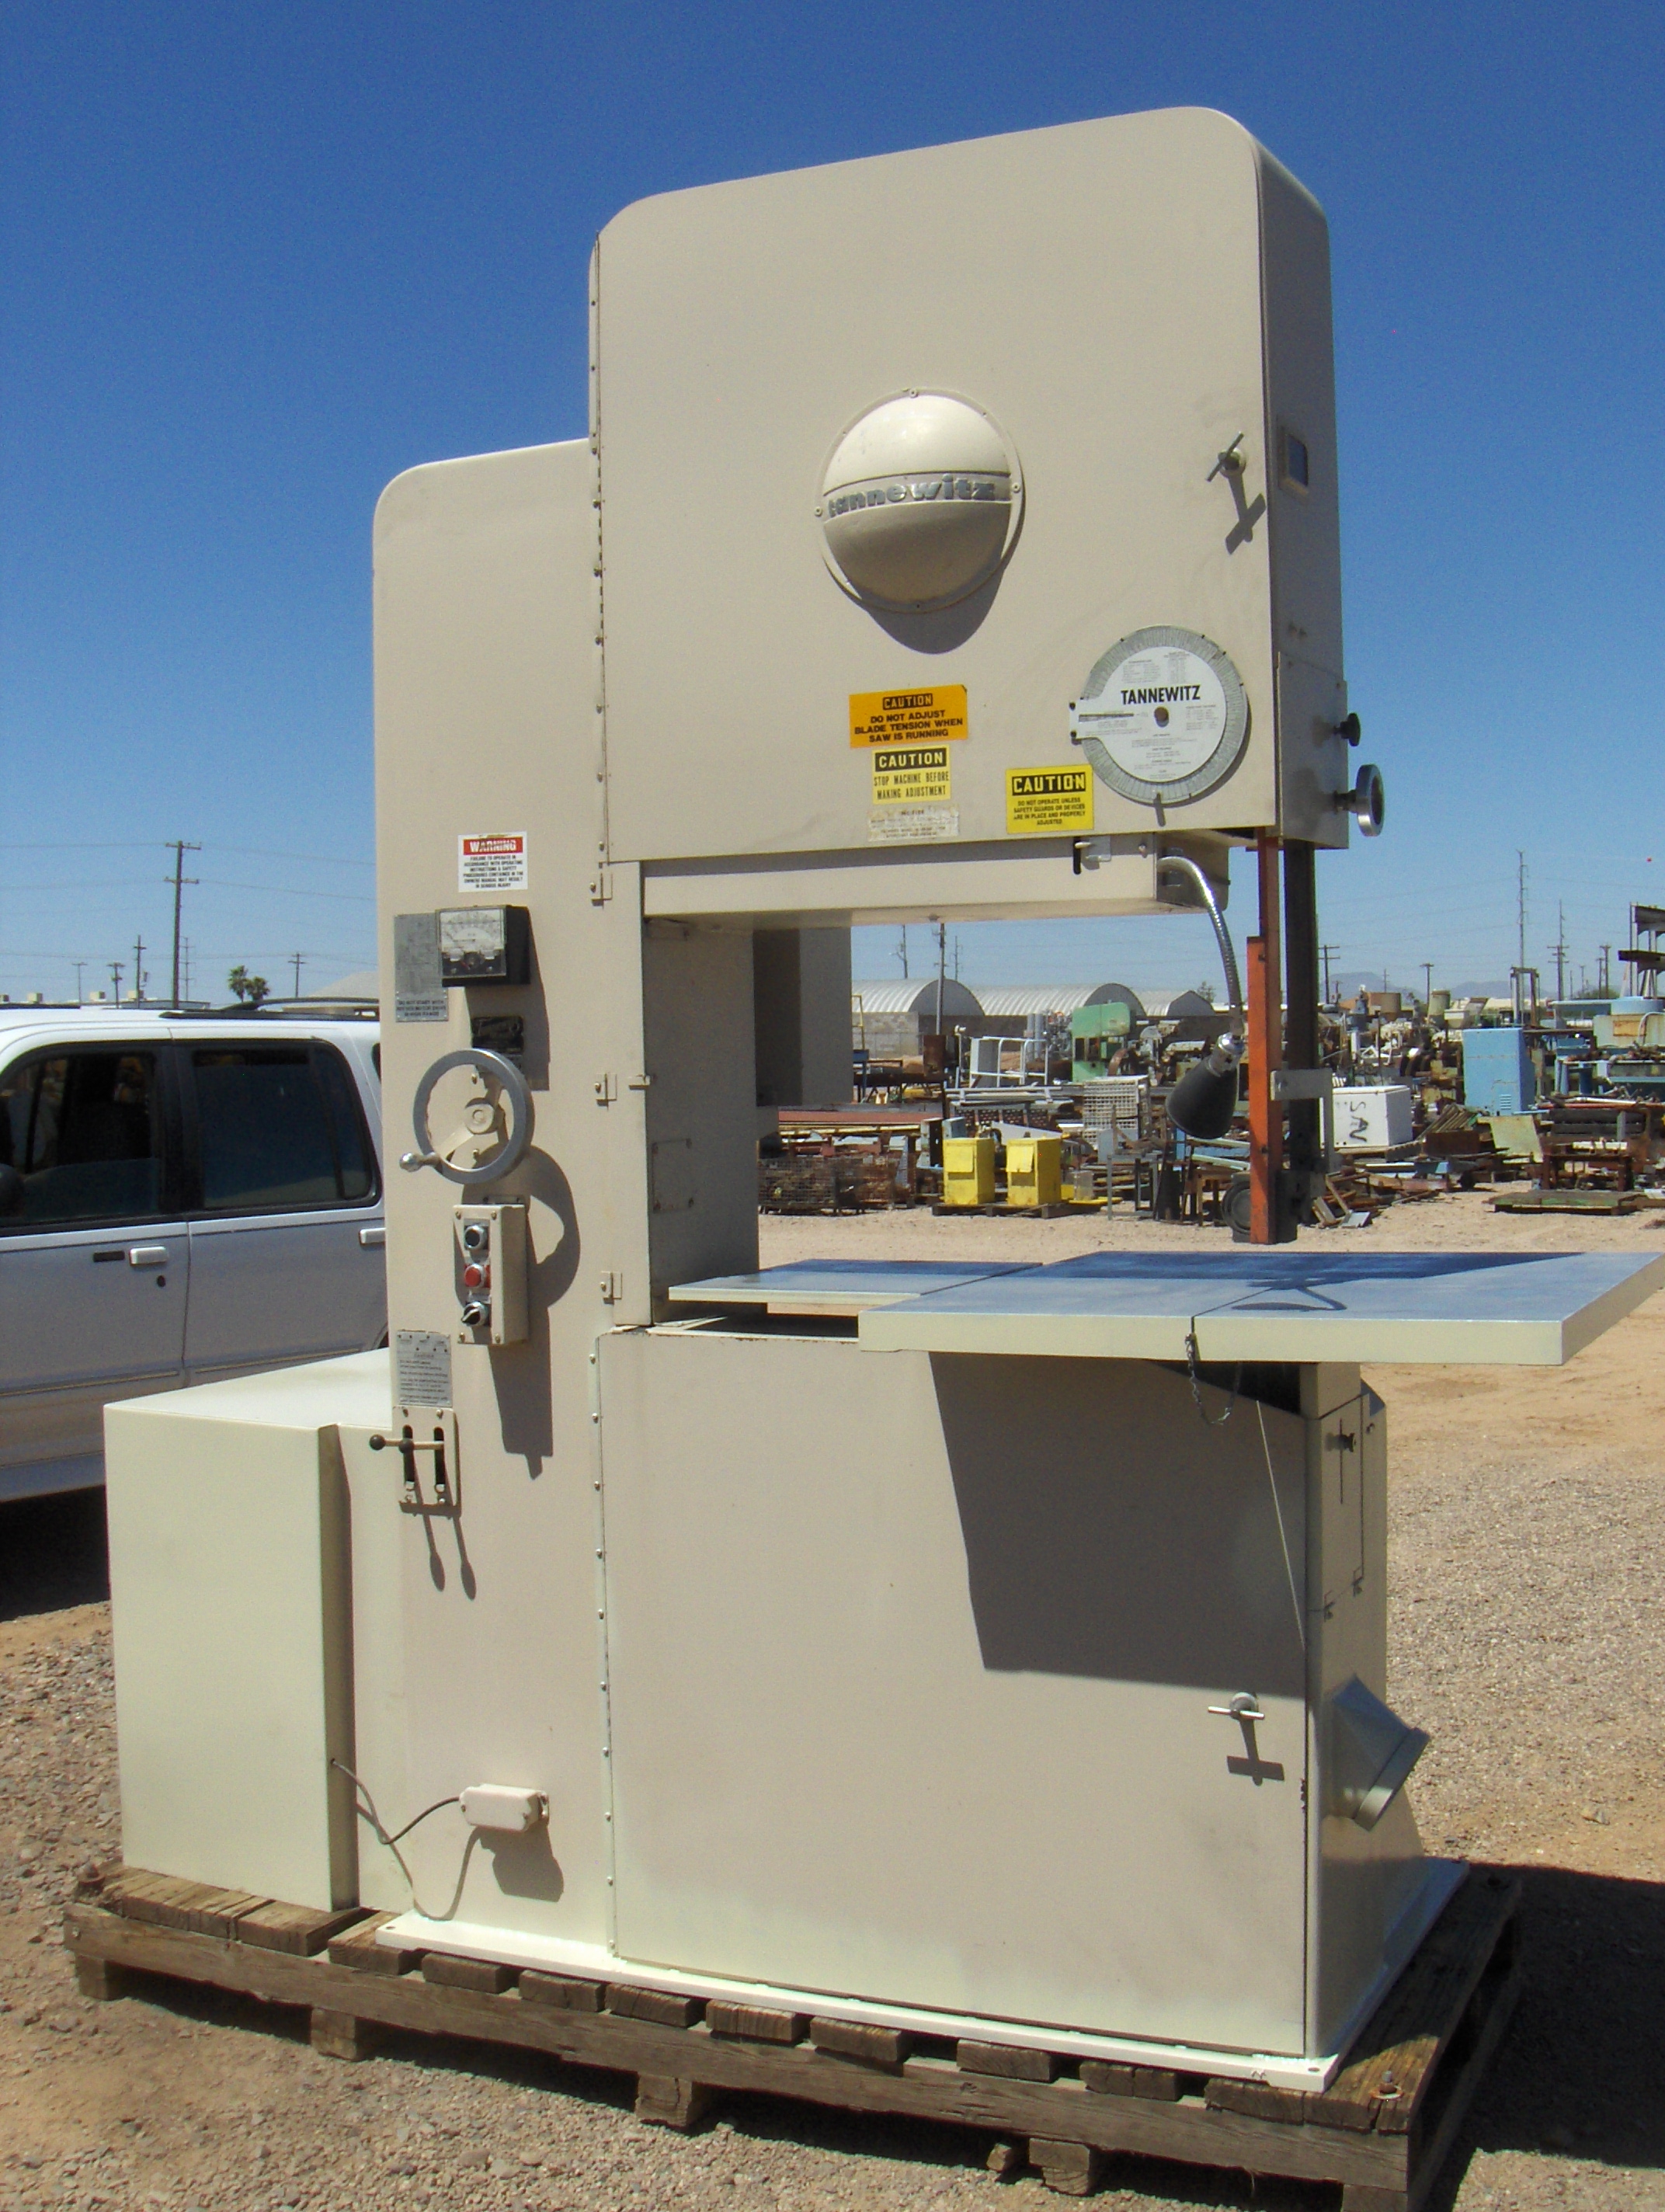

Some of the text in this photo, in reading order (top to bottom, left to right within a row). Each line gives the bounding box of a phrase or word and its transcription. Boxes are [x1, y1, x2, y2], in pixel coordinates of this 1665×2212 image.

[884, 694, 932, 708] CAUTION
[1121, 685, 1201, 704] TANNEWITZ
[886, 714, 905, 722] NOT
[909, 710, 945, 720] ADJUST
[854, 718, 963, 734] BLADE TENSION WHEN
[869, 733, 891, 743] SAW
[905, 729, 948, 739] RUNNING
[878, 751, 943, 768] CAUTION
[874, 770, 949, 786] STOP MACHINE BEFORE
[1013, 774, 1085, 793] CAUTION
[877, 785, 946, 799] MAKING ADJUSTMENT
[469, 839, 516, 853] WARNING
